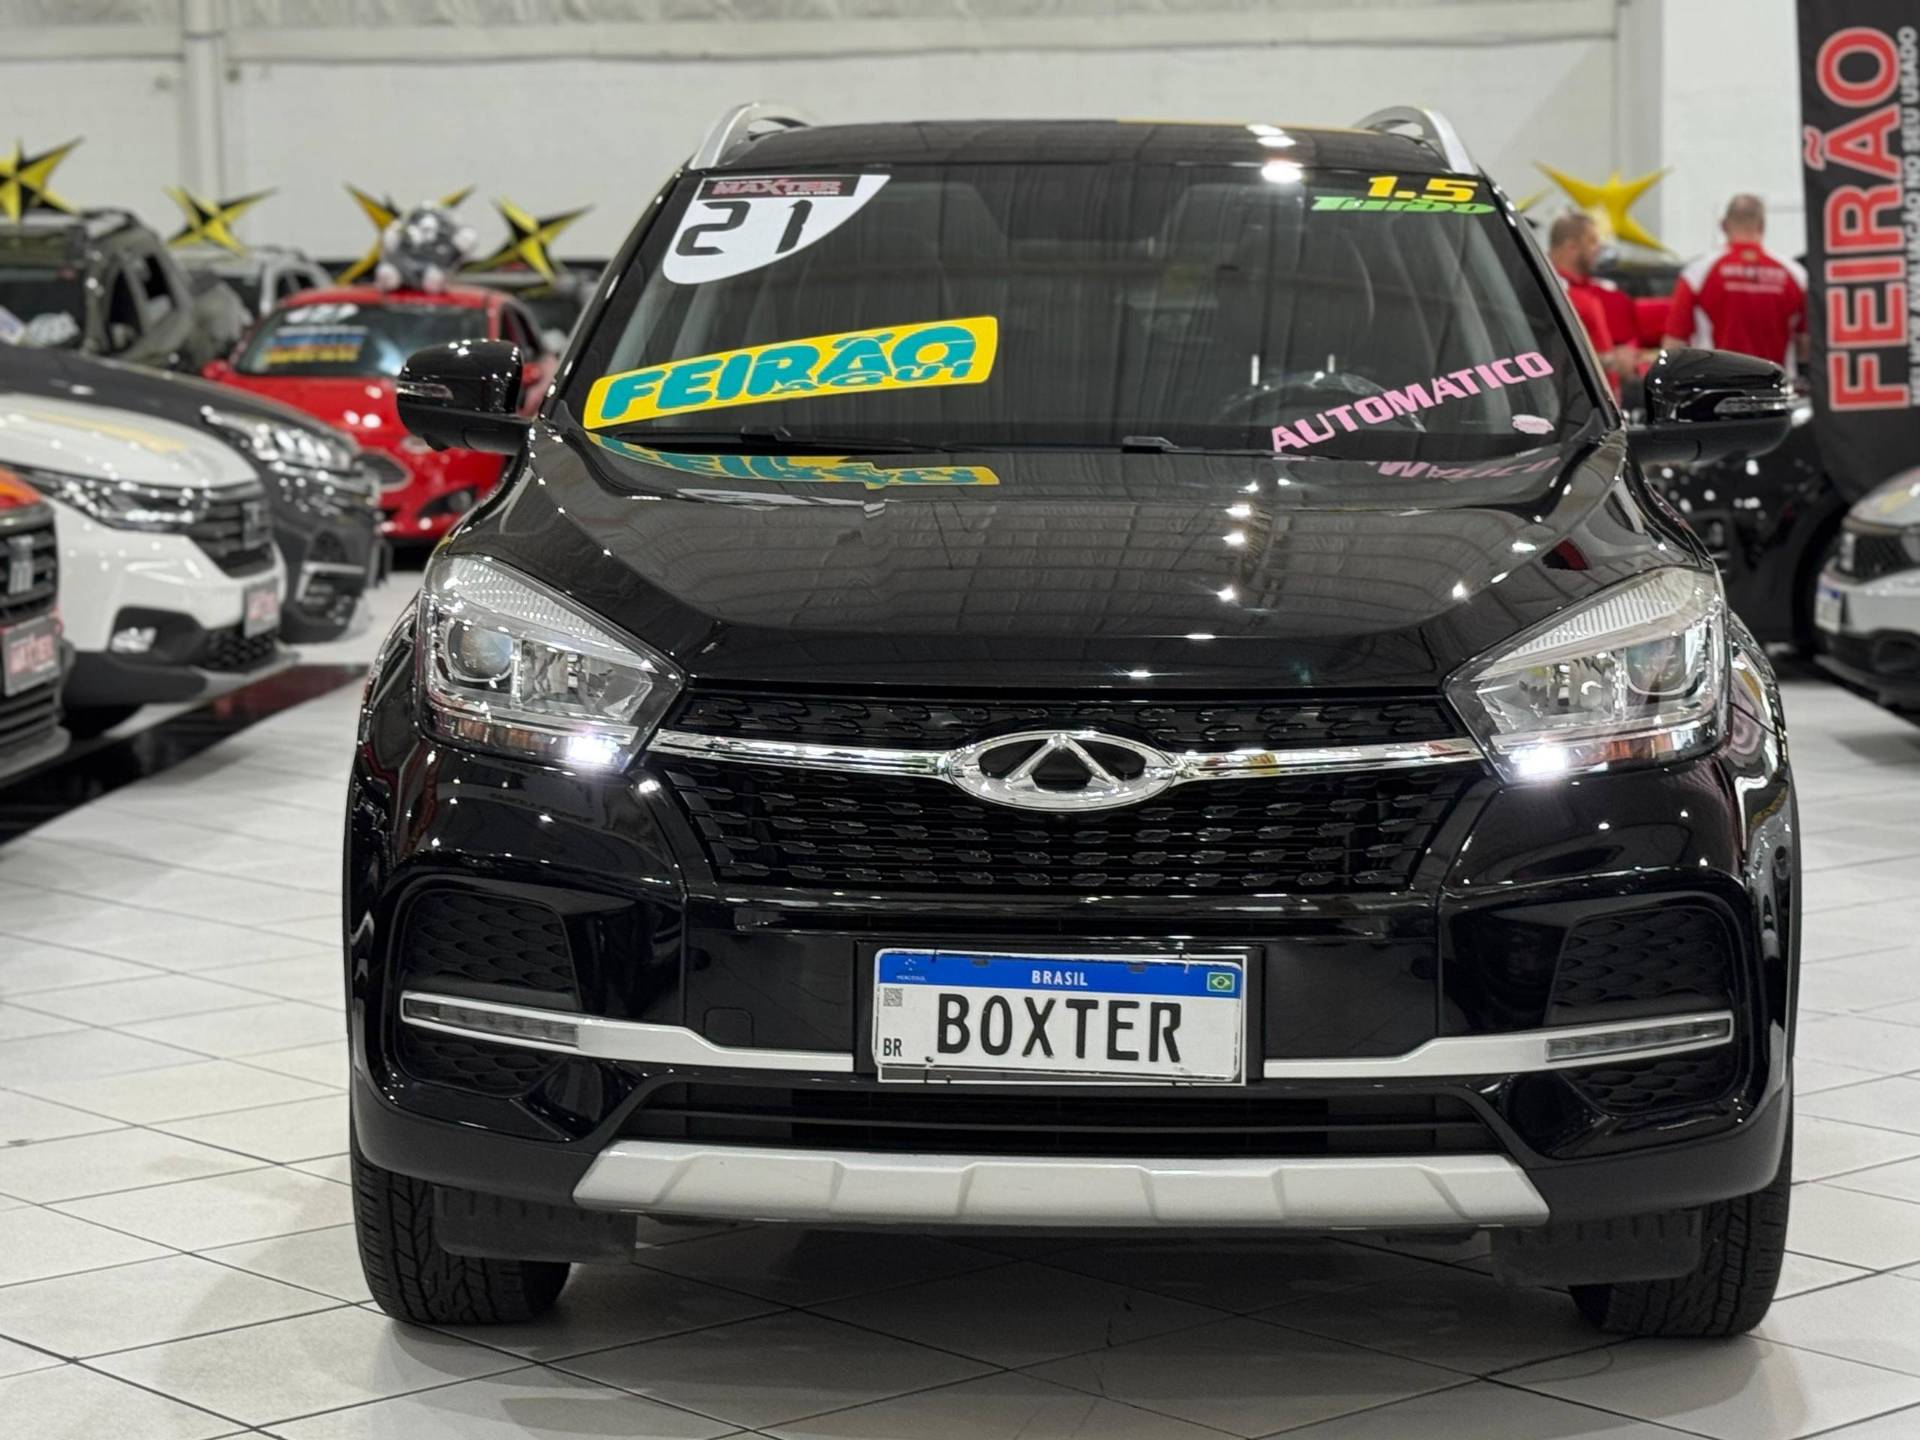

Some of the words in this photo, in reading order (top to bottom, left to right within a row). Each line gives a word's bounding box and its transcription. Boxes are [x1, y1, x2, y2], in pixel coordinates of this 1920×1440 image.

[1897, 26, 1919, 105] USADO
[1899, 107, 1919, 152] SEU
[711, 179, 842, 195] MAXTER
[1367, 175, 1479, 202] 1.5
[675, 199, 813, 257] 21
[1804, 27, 1910, 411] FEIRÃO
[600, 325, 977, 420] FEIRÃO
[1031, 970, 1088, 987] BRASIL
[882, 1038, 903, 1058] BR
[937, 993, 1182, 1063] BOXTER
